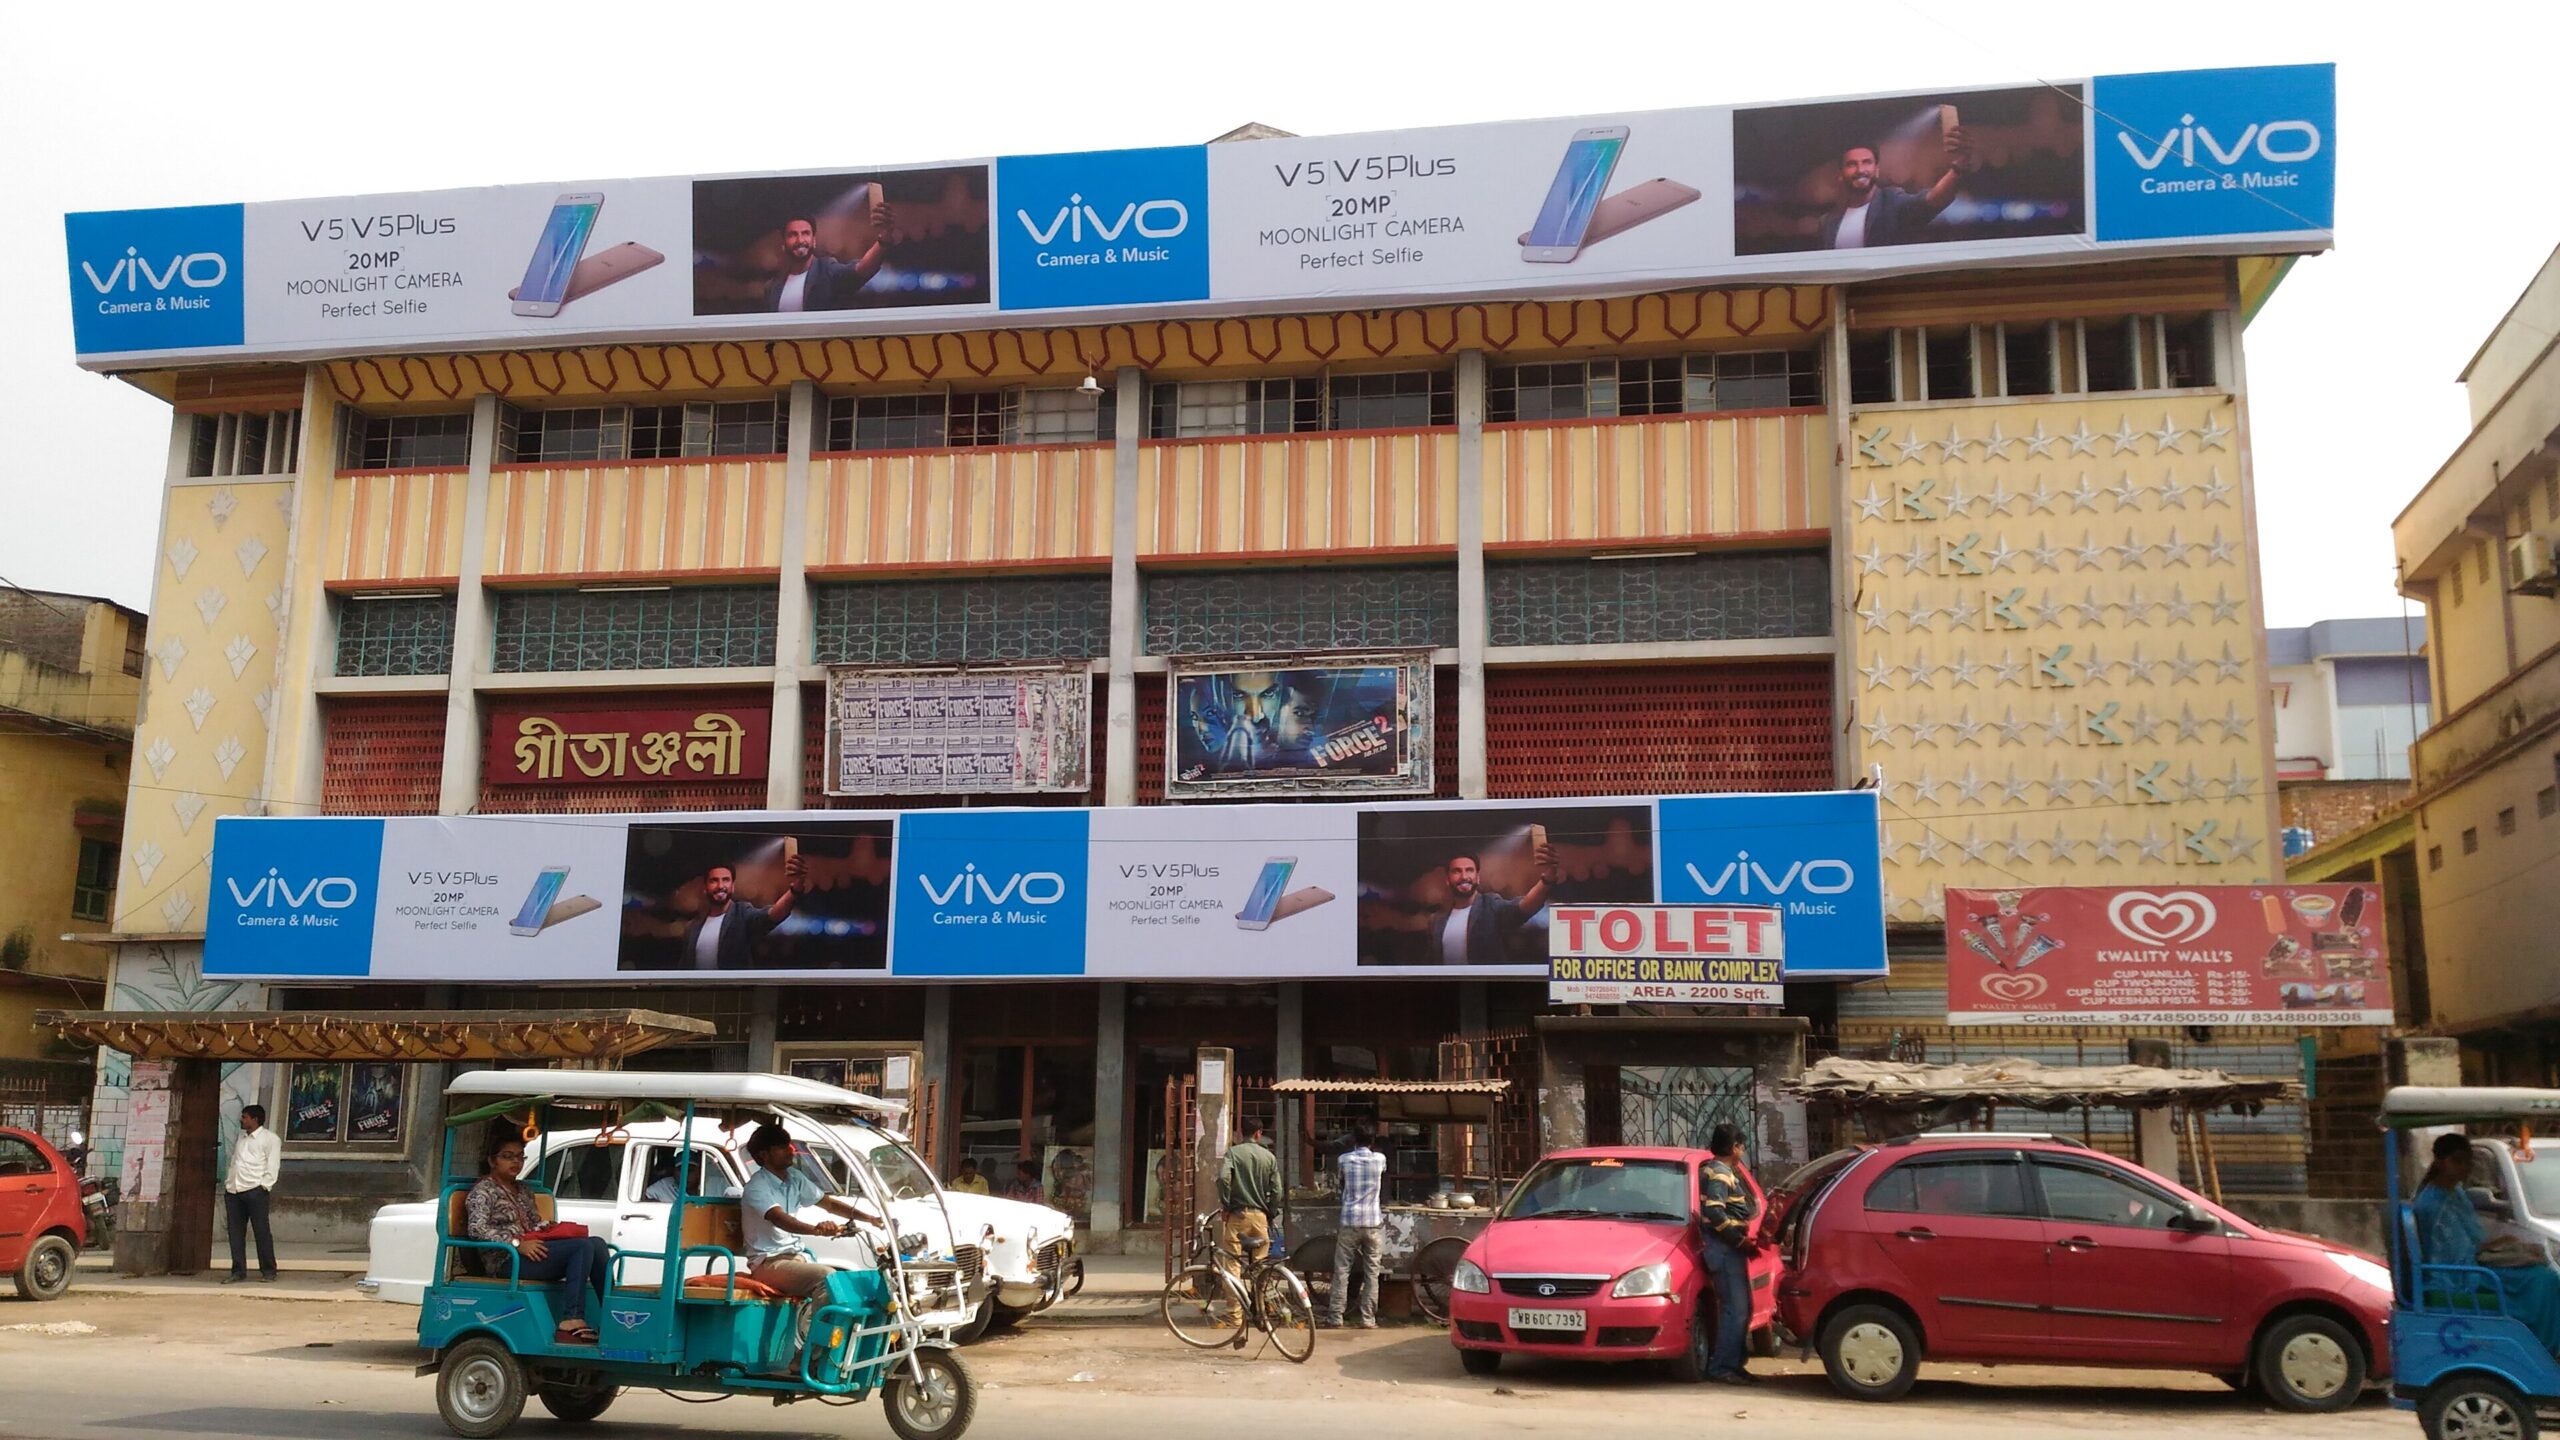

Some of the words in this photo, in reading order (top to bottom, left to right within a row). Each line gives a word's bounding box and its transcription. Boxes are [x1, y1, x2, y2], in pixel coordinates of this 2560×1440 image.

[2117, 113, 2321, 170] vivo
[1275, 161, 1325, 187] V5
[1334, 154, 1456, 183] V5Plus
[2140, 177, 2216, 194] Camera
[2222, 173, 2237, 189] &
[2243, 171, 2299, 188] Music
[1331, 195, 1391, 217] 20MP
[301, 219, 344, 242] V5
[351, 213, 456, 238] V5Plus
[1017, 192, 1189, 245] vivo
[1260, 222, 1378, 246] MOONLIGHT
[1385, 216, 1465, 237] CAMERA
[348, 251, 400, 270] 20MP
[1036, 252, 1100, 267] Camera
[1105, 248, 1117, 263] &
[1122, 246, 1169, 262] Music
[1300, 250, 1364, 270] Perfect
[1372, 247, 1423, 265] Selfie
[82, 246, 227, 294] vivo
[287, 275, 389, 296] MOONLIGHT
[394, 272, 463, 290] CAMERA
[98, 300, 151, 314] Camera
[155, 297, 167, 311] &
[170, 295, 211, 310] Music
[322, 300, 376, 318] Perfect
[383, 299, 427, 315] Selfie
[1310, 725, 1386, 768] FORCE
[437, 871, 498, 885] V5Plus
[1152, 863, 1220, 878] V5Plus
[1686, 850, 1854, 896] vivo
[227, 867, 357, 908] vivo
[919, 862, 1065, 905] vivo
[1150, 885, 1184, 897] 20MP
[433, 892, 465, 903] 20MP
[1109, 900, 1175, 910] MOONLIGHT
[1178, 899, 1224, 910] CAMERA
[395, 906, 456, 916] MOONLIGHT
[459, 906, 500, 916] CAMERA
[933, 911, 988, 924] Camera
[991, 911, 1002, 924] &
[1007, 910, 1047, 924] Music
[1789, 901, 1837, 915] Music
[237, 913, 286, 926] Camera
[289, 914, 299, 926] &
[302, 914, 339, 926] Music
[414, 920, 448, 930] Perfect
[450, 920, 478, 930] Selfie
[1131, 915, 1167, 925] Perfect
[1171, 914, 1201, 925] Selfie
[1557, 909, 1644, 952] TO
[1654, 910, 1774, 954] LET
[2096, 950, 2170, 963] KWALITY
[2176, 950, 2233, 963] WALL'S
[1553, 959, 1582, 980] FOR
[1585, 959, 1636, 980] OFFICE
[1640, 959, 1661, 981] OR
[1664, 960, 1705, 981] BANK
[1708, 960, 1779, 982] COMPLEX
[2113, 970, 2139, 979] CUP
[2140, 970, 2193, 978] VANILLA
[2066, 988, 2093, 997] CUP
[2094, 988, 2143, 997] BUTTER
[2094, 979, 2120, 988] CUP
[1633, 986, 1676, 998] AREA
[1690, 987, 1728, 998] 2200
[1733, 987, 1770, 1001] Sqft.
[2081, 997, 2107, 1006] CUP
[2108, 997, 2160, 1005] KESHAR
[2119, 1013, 2229, 1023] 9474850550
